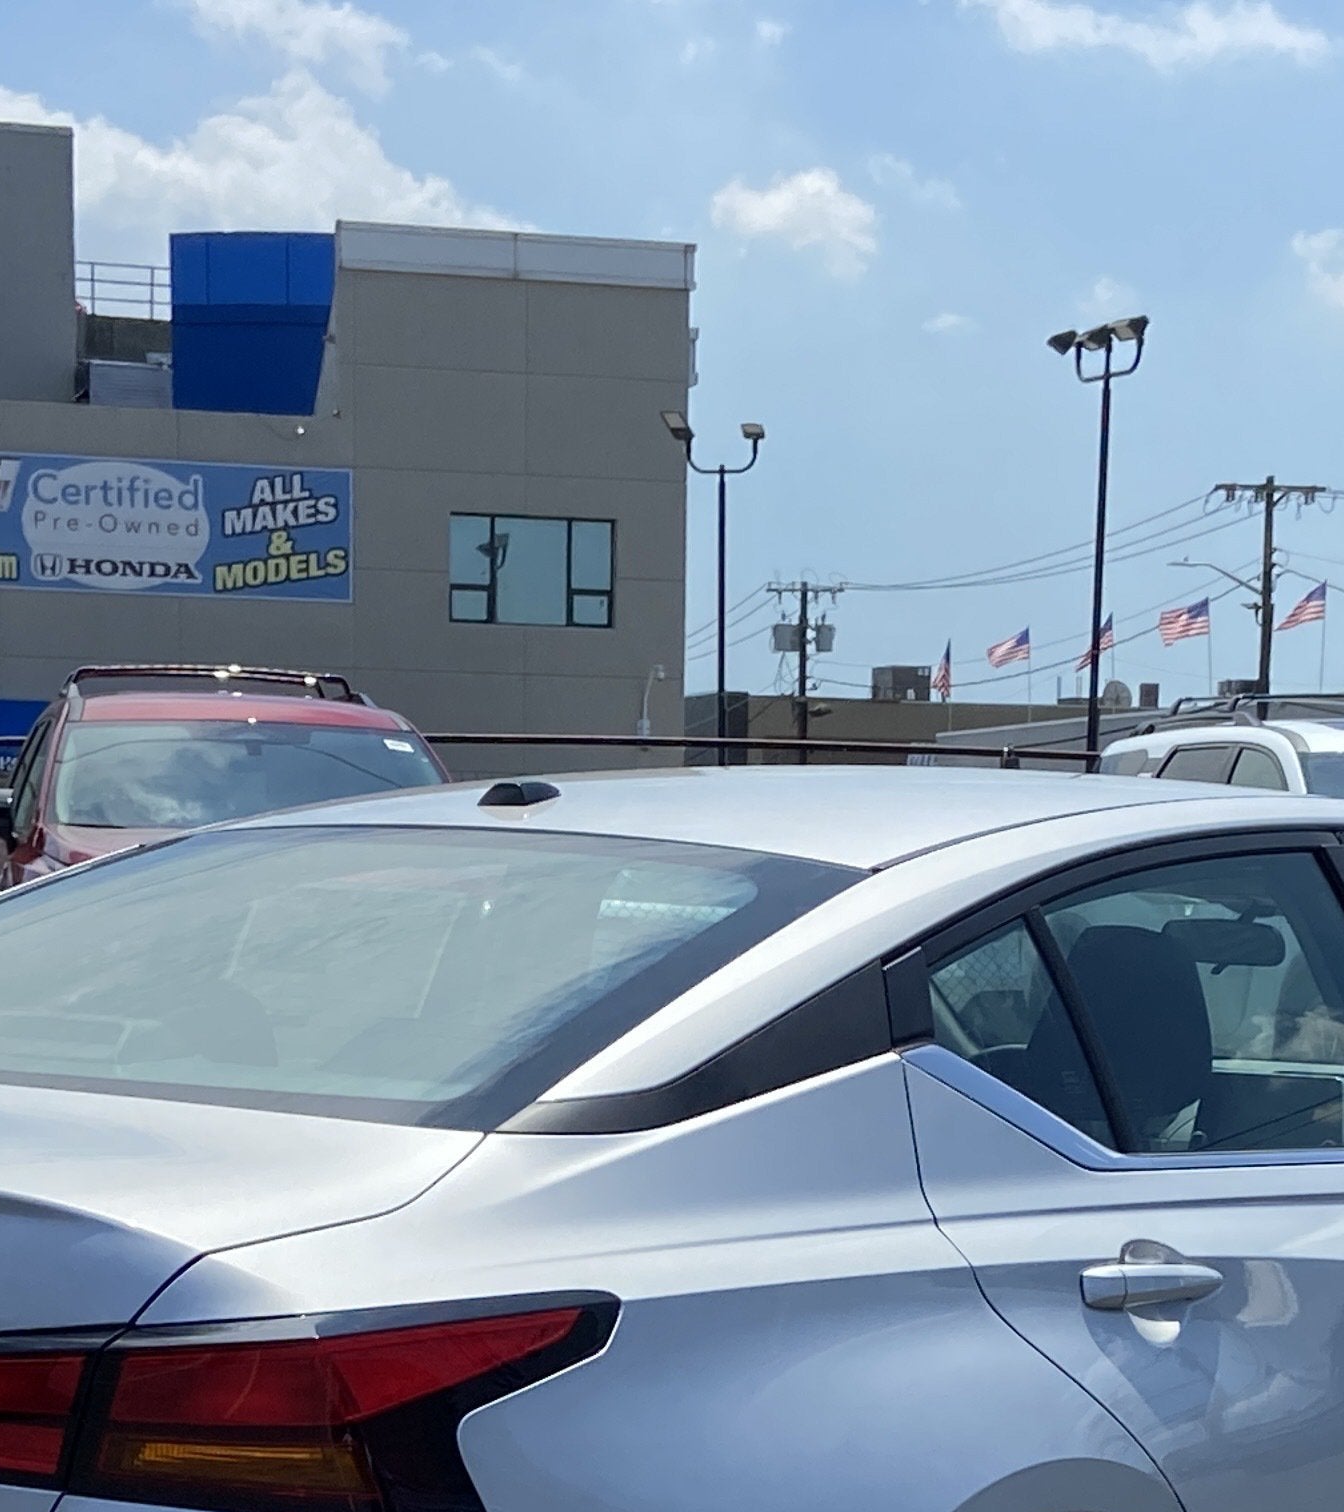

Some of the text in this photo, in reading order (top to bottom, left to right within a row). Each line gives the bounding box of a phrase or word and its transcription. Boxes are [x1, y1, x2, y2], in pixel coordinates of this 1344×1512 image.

[33, 472, 200, 511] Certified
[252, 474, 311, 505] ALL
[34, 511, 200, 537] Pre-Owned
[224, 497, 337, 537] MAKES
[268, 529, 295, 556] &
[67, 558, 199, 581] HONDA
[214, 550, 348, 591] MODELS
